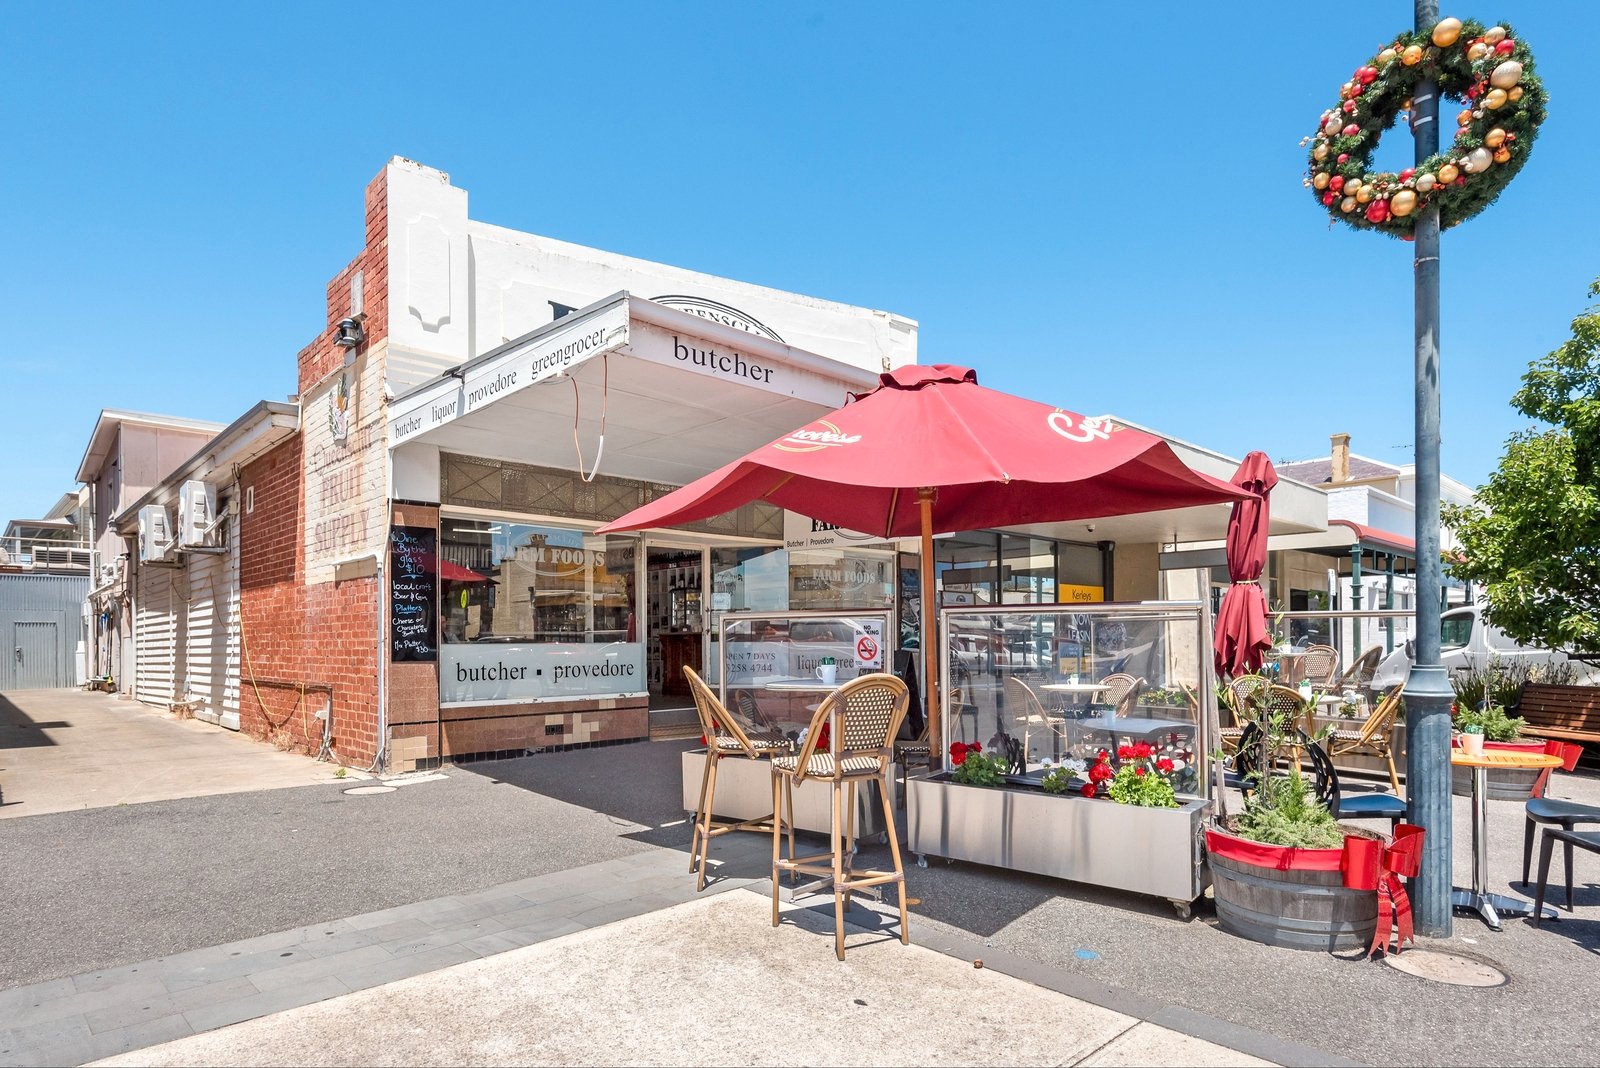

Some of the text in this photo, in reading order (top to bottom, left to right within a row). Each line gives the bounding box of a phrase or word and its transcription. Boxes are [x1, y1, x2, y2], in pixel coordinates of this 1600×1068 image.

[672, 335, 774, 384] butcher
[394, 327, 607, 440] butcher liquor provedore greengrocer
[321, 461, 364, 509] FRUIT
[315, 508, 370, 552] SUPPLY
[786, 537, 834, 548] Butcher Provedore
[398, 556, 423, 568] glass
[495, 544, 546, 563] FARM
[551, 548, 605, 567] FOODS
[405, 563, 425, 574] $10
[812, 568, 840, 581] FARM
[844, 570, 876, 584] FOODS
[1072, 589, 1092, 601] Kerleys
[395, 604, 423, 612] Platters
[1068, 629, 1091, 641] LEASIN
[726, 652, 776, 660] PEN 7 DAYS
[456, 659, 634, 683] butcher provedore
[750, 663, 773, 672] 4744
[835, 657, 854, 673] gree
